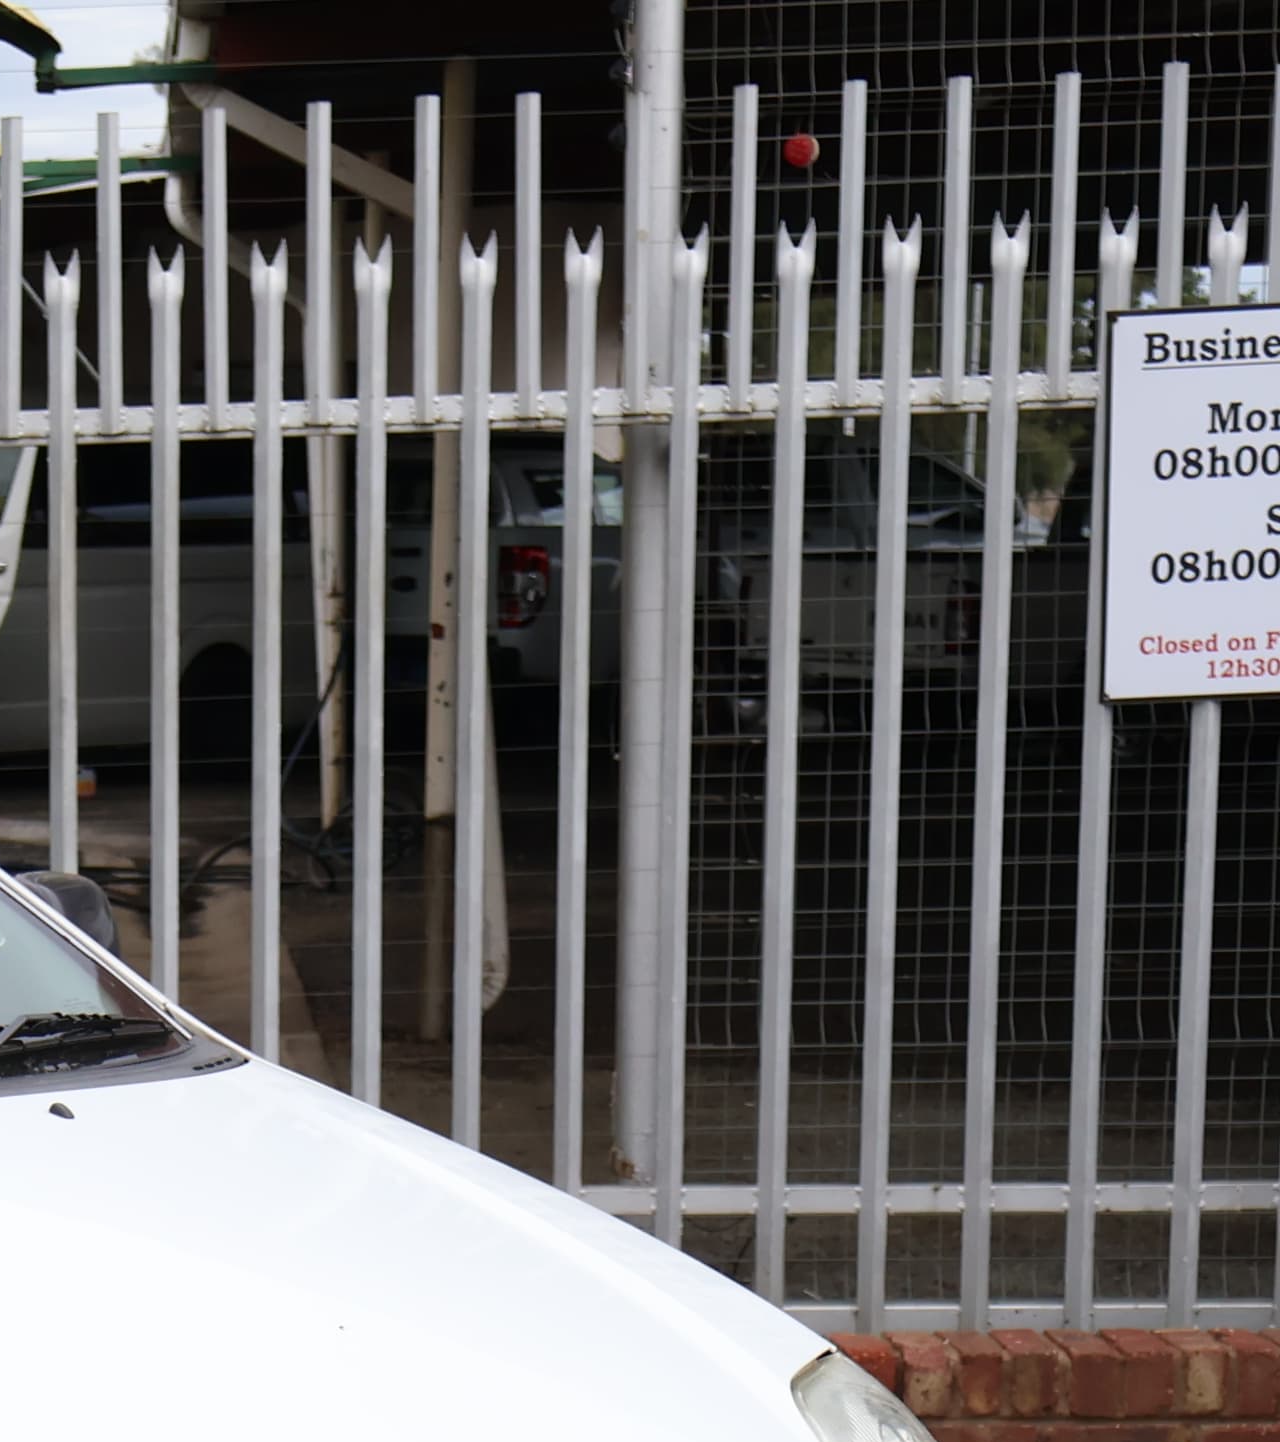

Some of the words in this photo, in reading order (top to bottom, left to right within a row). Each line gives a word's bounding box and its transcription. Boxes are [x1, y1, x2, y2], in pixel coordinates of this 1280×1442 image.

[1144, 328, 1280, 363] Busine
[1154, 445, 1280, 480] 08h00
[1151, 548, 1280, 584] 08h00
[1139, 633, 1218, 655] Closed
[1227, 637, 1256, 651] on
[1207, 657, 1280, 679] 12h30
